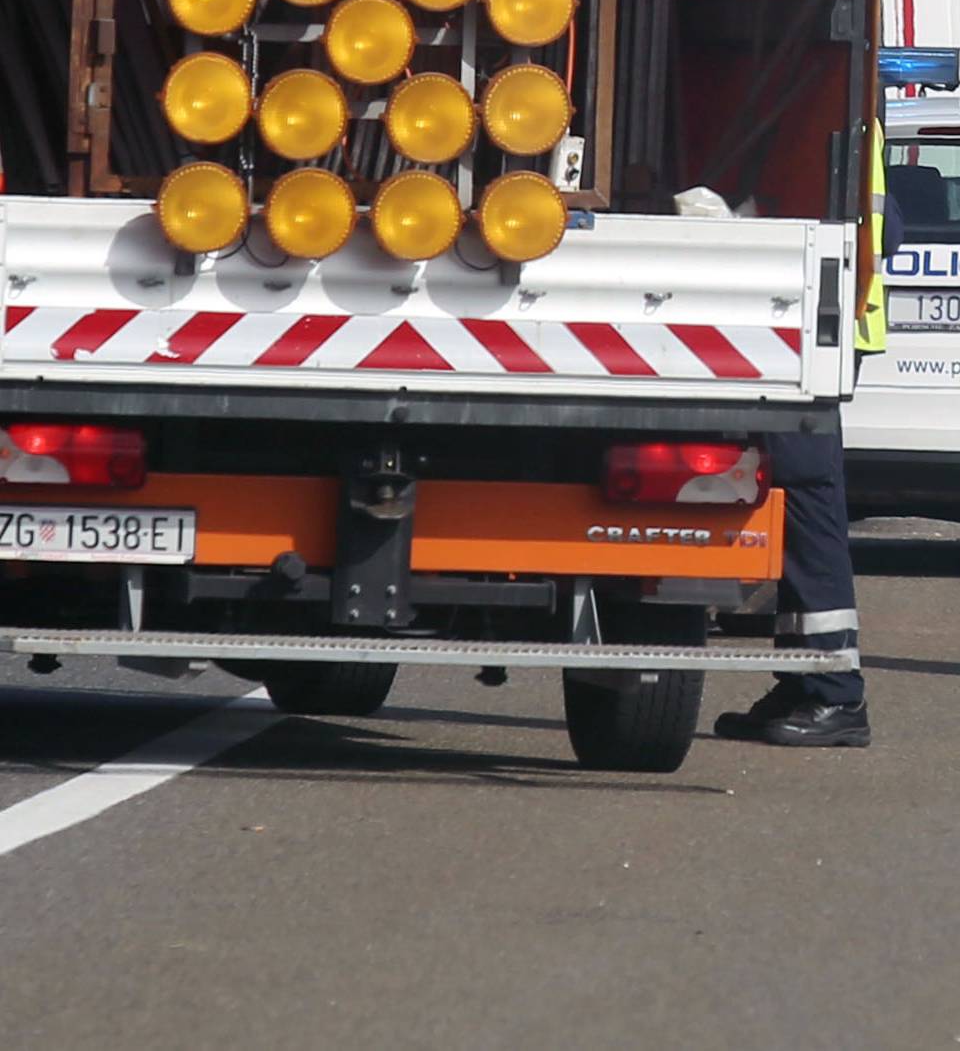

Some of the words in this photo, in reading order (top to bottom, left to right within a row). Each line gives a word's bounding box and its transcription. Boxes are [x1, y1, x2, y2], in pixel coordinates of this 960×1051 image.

[0, 513, 35, 548] ZG
[587, 525, 712, 547] CRAFTER
[724, 529, 768, 548] TDI
